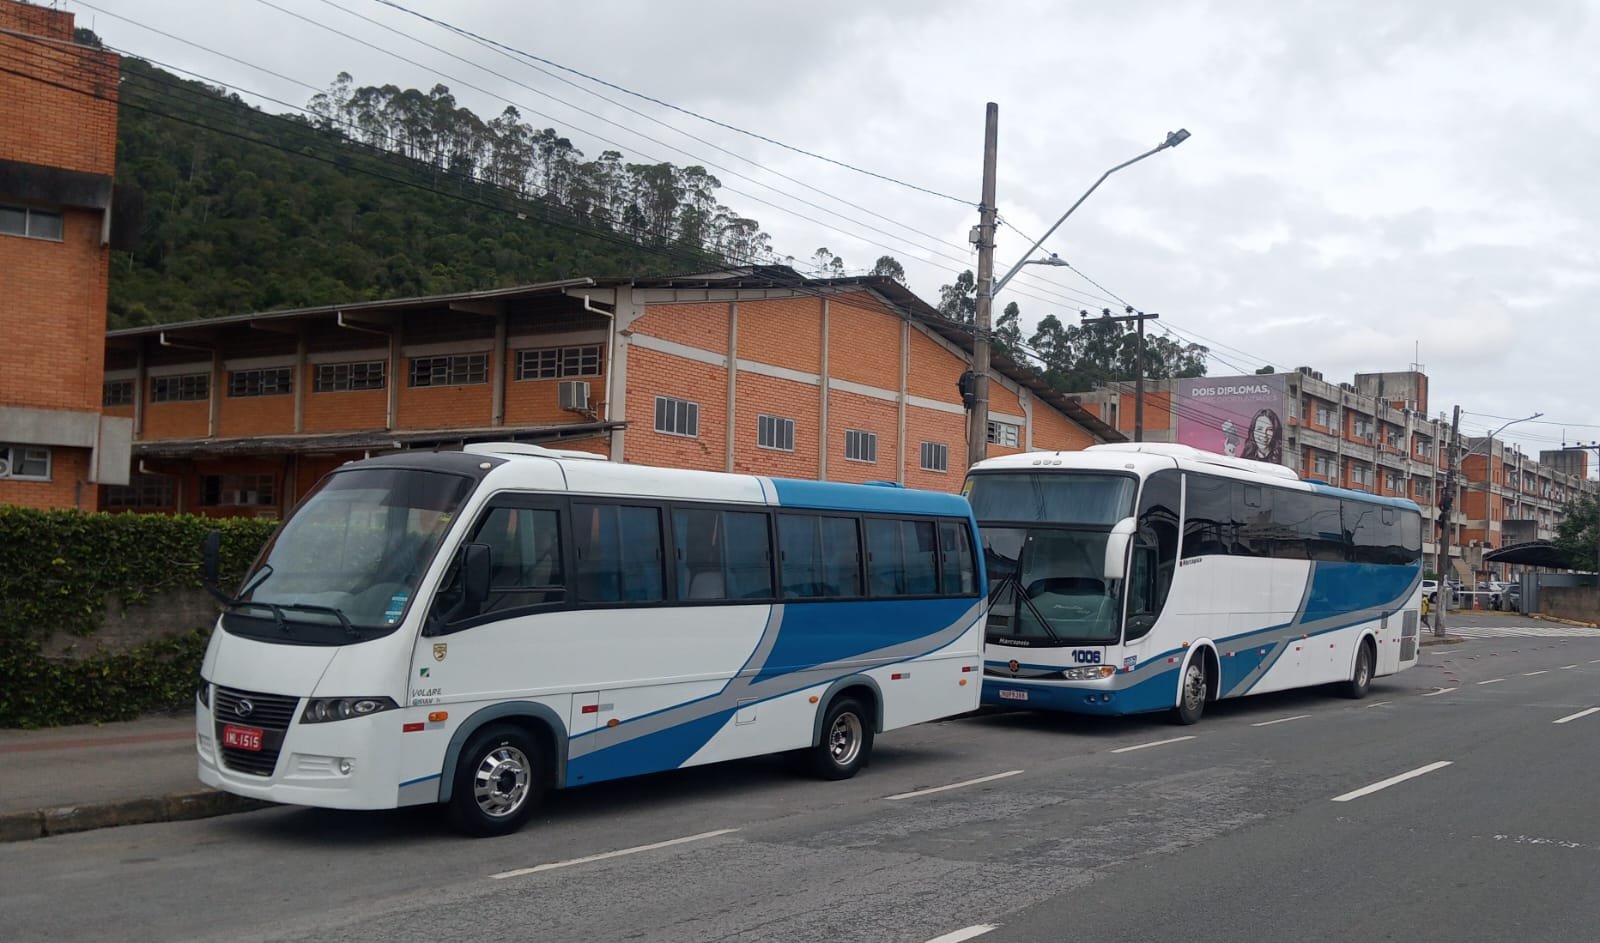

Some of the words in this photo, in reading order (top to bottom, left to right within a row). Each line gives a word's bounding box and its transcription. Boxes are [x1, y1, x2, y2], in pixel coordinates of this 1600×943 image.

[1192, 387, 1216, 396] DOIS
[1217, 385, 1271, 395] DIPLOMAS,
[1071, 649, 1101, 663] 1006
[412, 688, 442, 697] VOLARE
